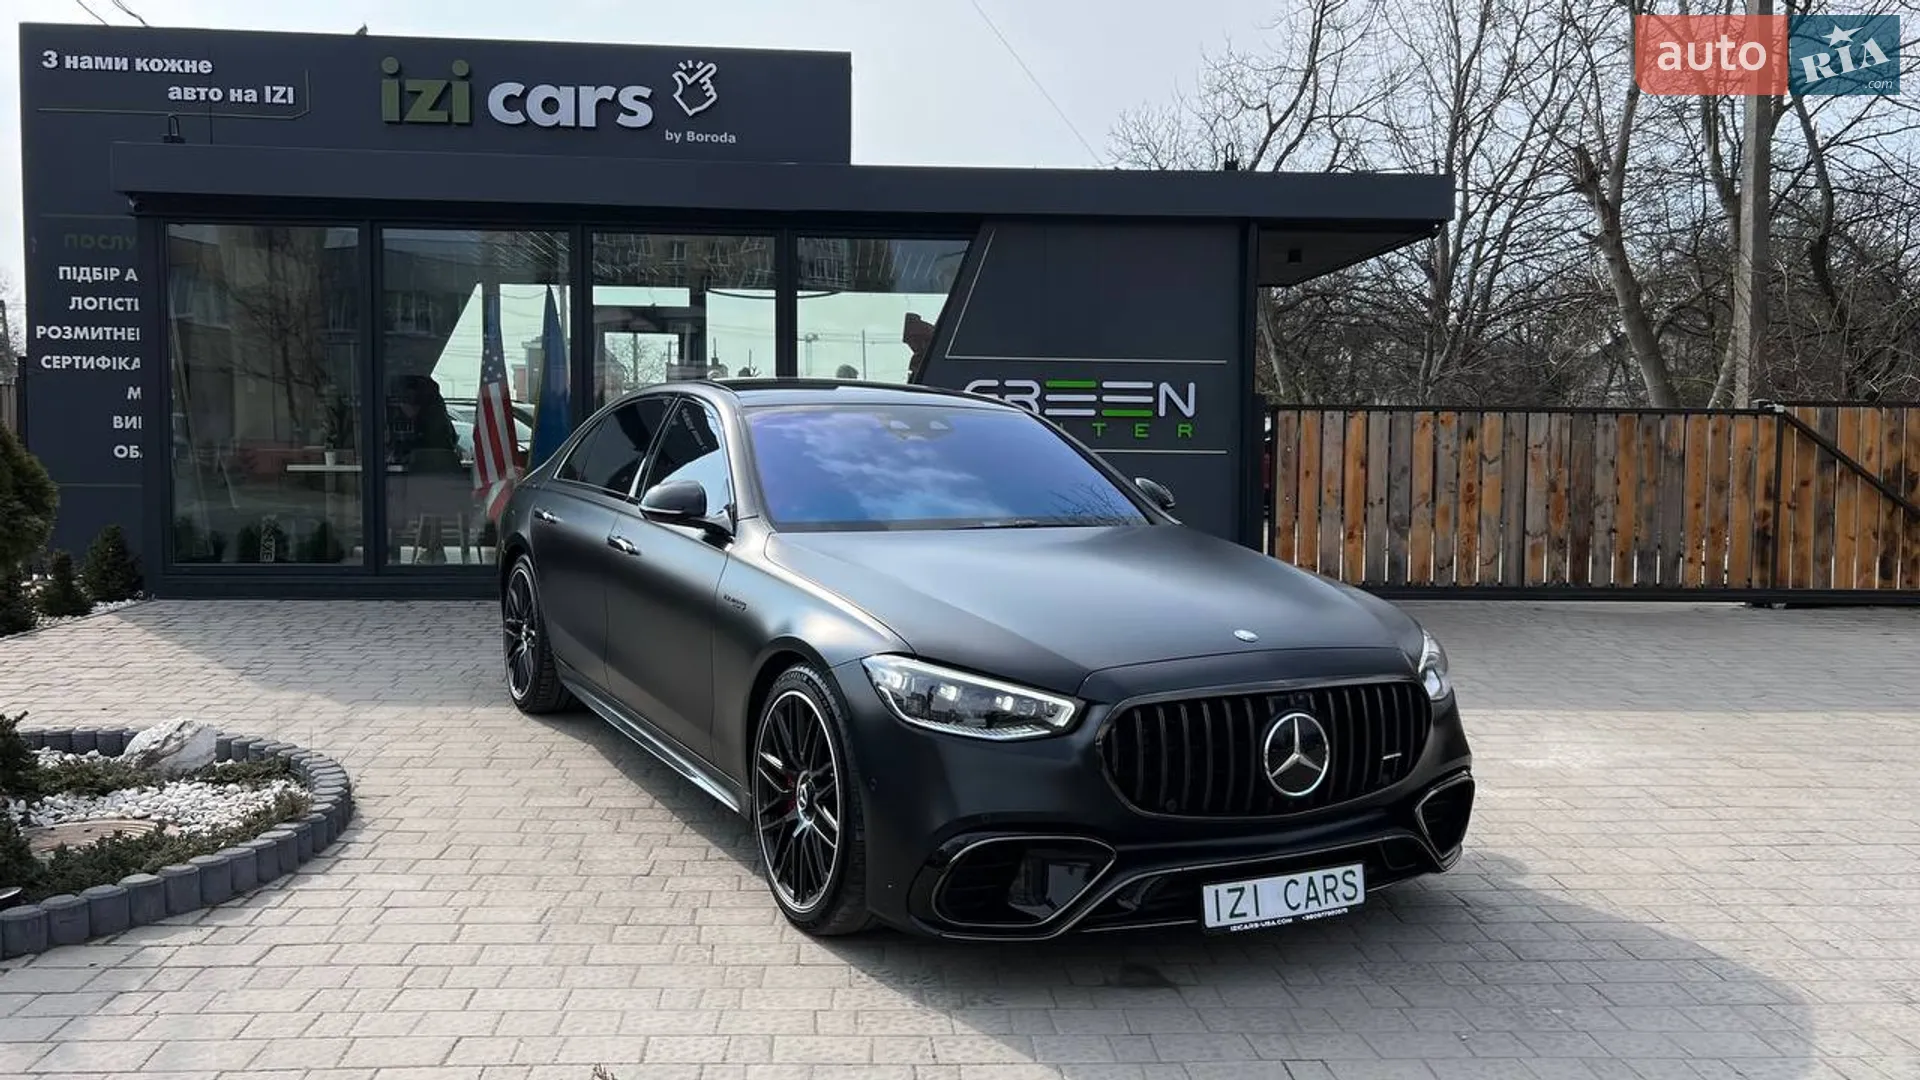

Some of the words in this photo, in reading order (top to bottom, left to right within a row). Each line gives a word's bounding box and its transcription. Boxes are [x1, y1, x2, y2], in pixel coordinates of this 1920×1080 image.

[64, 54, 129, 72] нами
[135, 56, 213, 74] кожне
[168, 84, 223, 102] авто
[229, 86, 258, 103] на
[264, 85, 294, 104] IZI
[381, 56, 472, 124] izi
[487, 82, 653, 128] cars
[665, 128, 682, 144] by
[686, 130, 737, 144] Boroda
[58, 265, 121, 283] ПІДБІР
[36, 325, 140, 341] РОЗМИТНЕ
[40, 355, 141, 370] СЕРТИФІКА
[113, 415, 142, 429] ВИ
[1058, 422, 1194, 438] TER
[113, 444, 143, 459] ОБ
[1214, 884, 1260, 922] IZI
[1283, 869, 1359, 912] CARS
